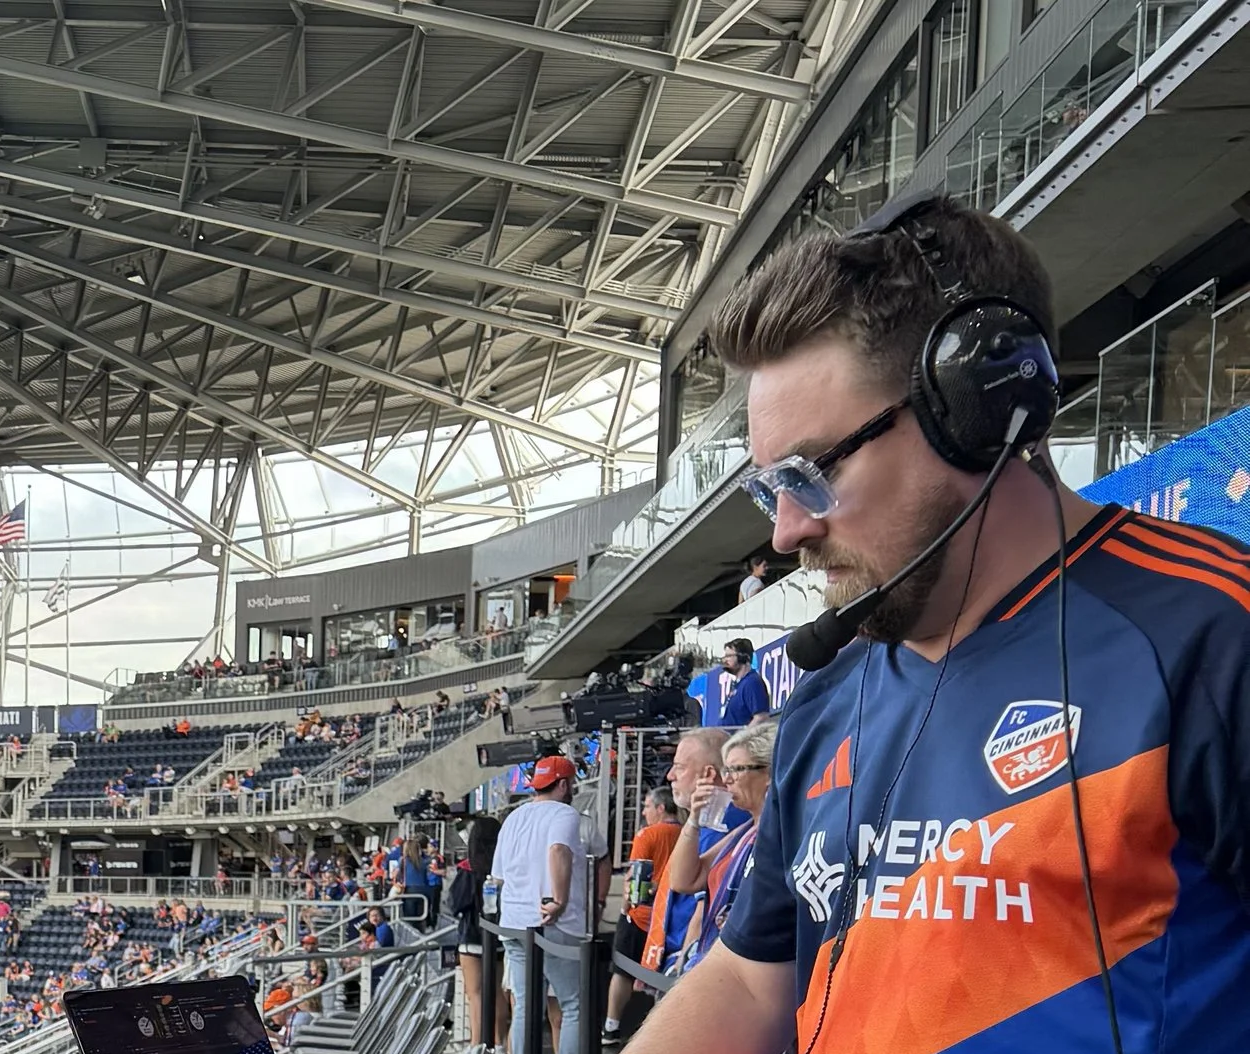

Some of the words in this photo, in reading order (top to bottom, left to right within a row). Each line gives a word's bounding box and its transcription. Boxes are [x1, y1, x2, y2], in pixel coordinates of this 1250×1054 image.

[989, 711, 1077, 758] CINCINNAI
[1010, 709, 1028, 725] FC
[857, 818, 1015, 866] MERCY
